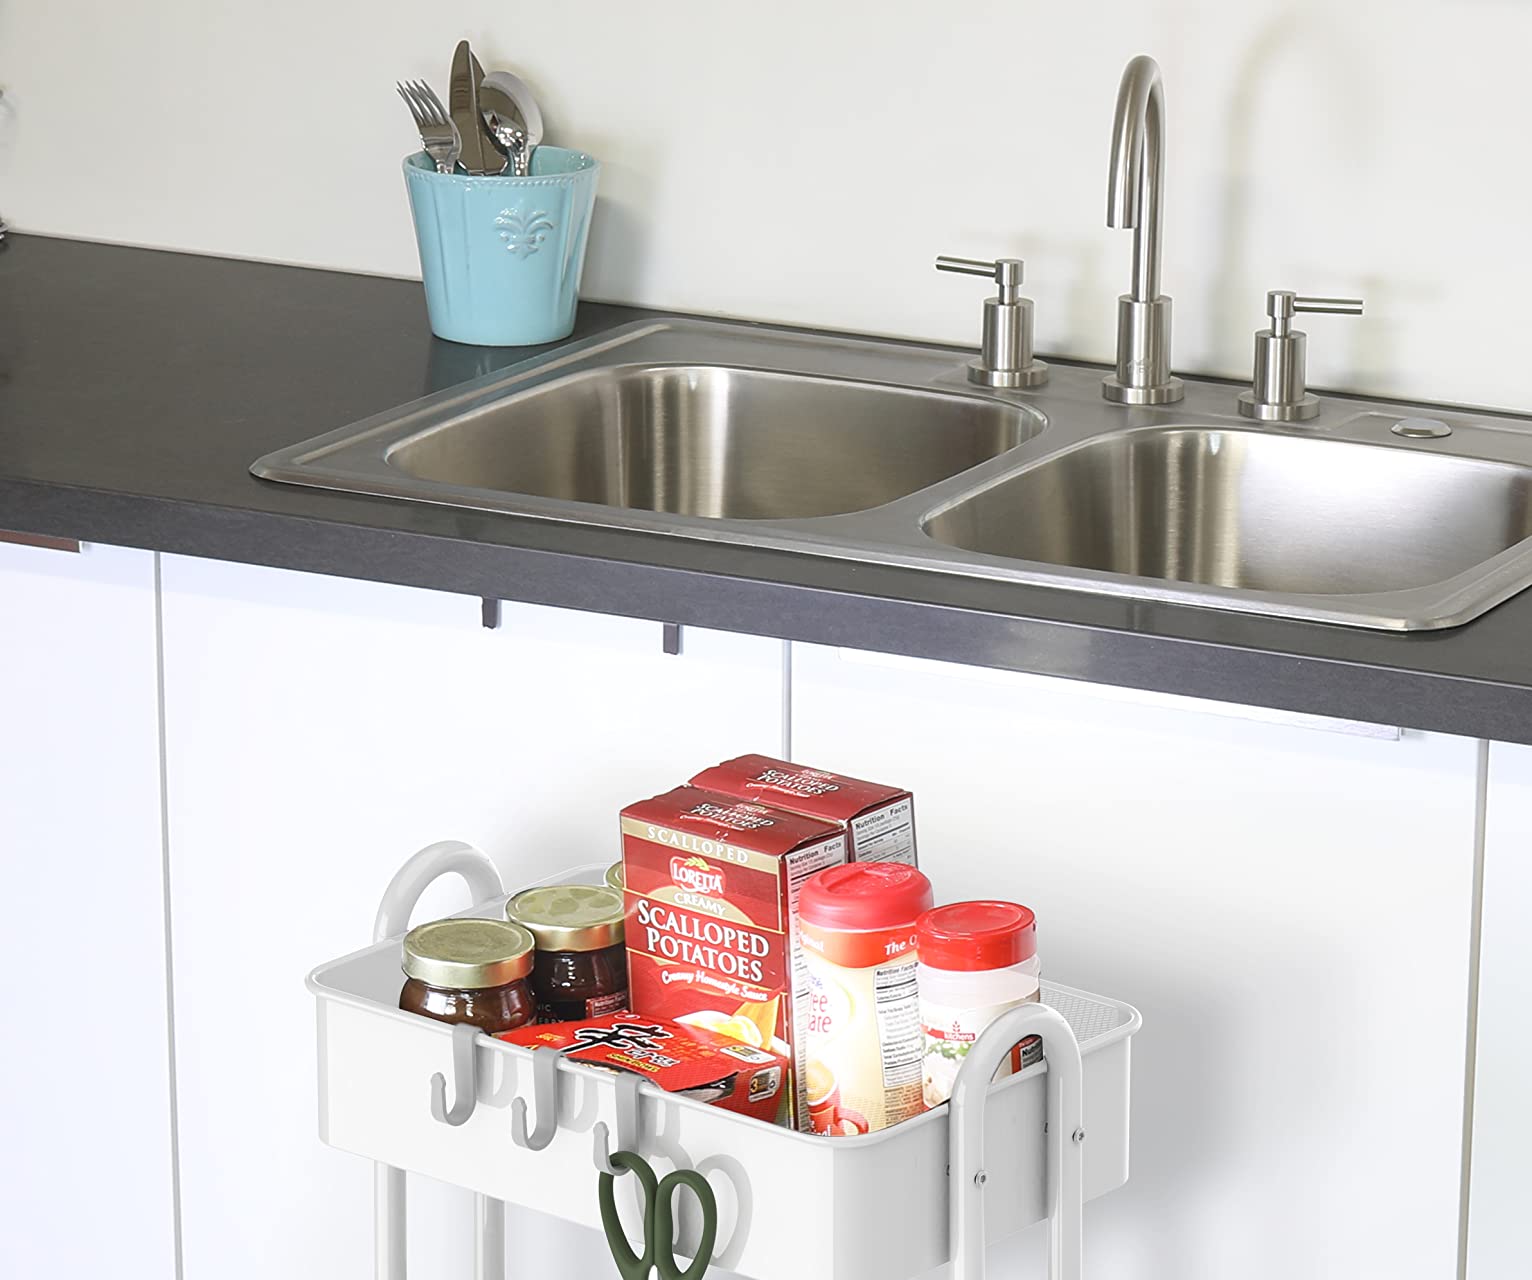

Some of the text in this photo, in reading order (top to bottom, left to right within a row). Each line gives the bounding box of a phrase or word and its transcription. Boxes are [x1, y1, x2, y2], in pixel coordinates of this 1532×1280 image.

[757, 775, 823, 795] POTATOES
[766, 769, 839, 792] SCALLOPED
[690, 809, 758, 829] POTATOES
[700, 803, 774, 826] SCALLOPED
[855, 804, 908, 830] Nutrition Facts
[648, 826, 749, 864] SCALLOPED
[789, 850, 819, 865] Nutrition
[823, 842, 842, 854] Facts
[673, 862, 723, 894] LORETTA
[674, 892, 725, 917] CREAMY
[638, 899, 769, 957] SCALLOPED
[646, 926, 763, 982] POTATOES
[884, 941, 906, 956] The
[661, 970, 768, 1001] Creamy Homestyle Sauce
